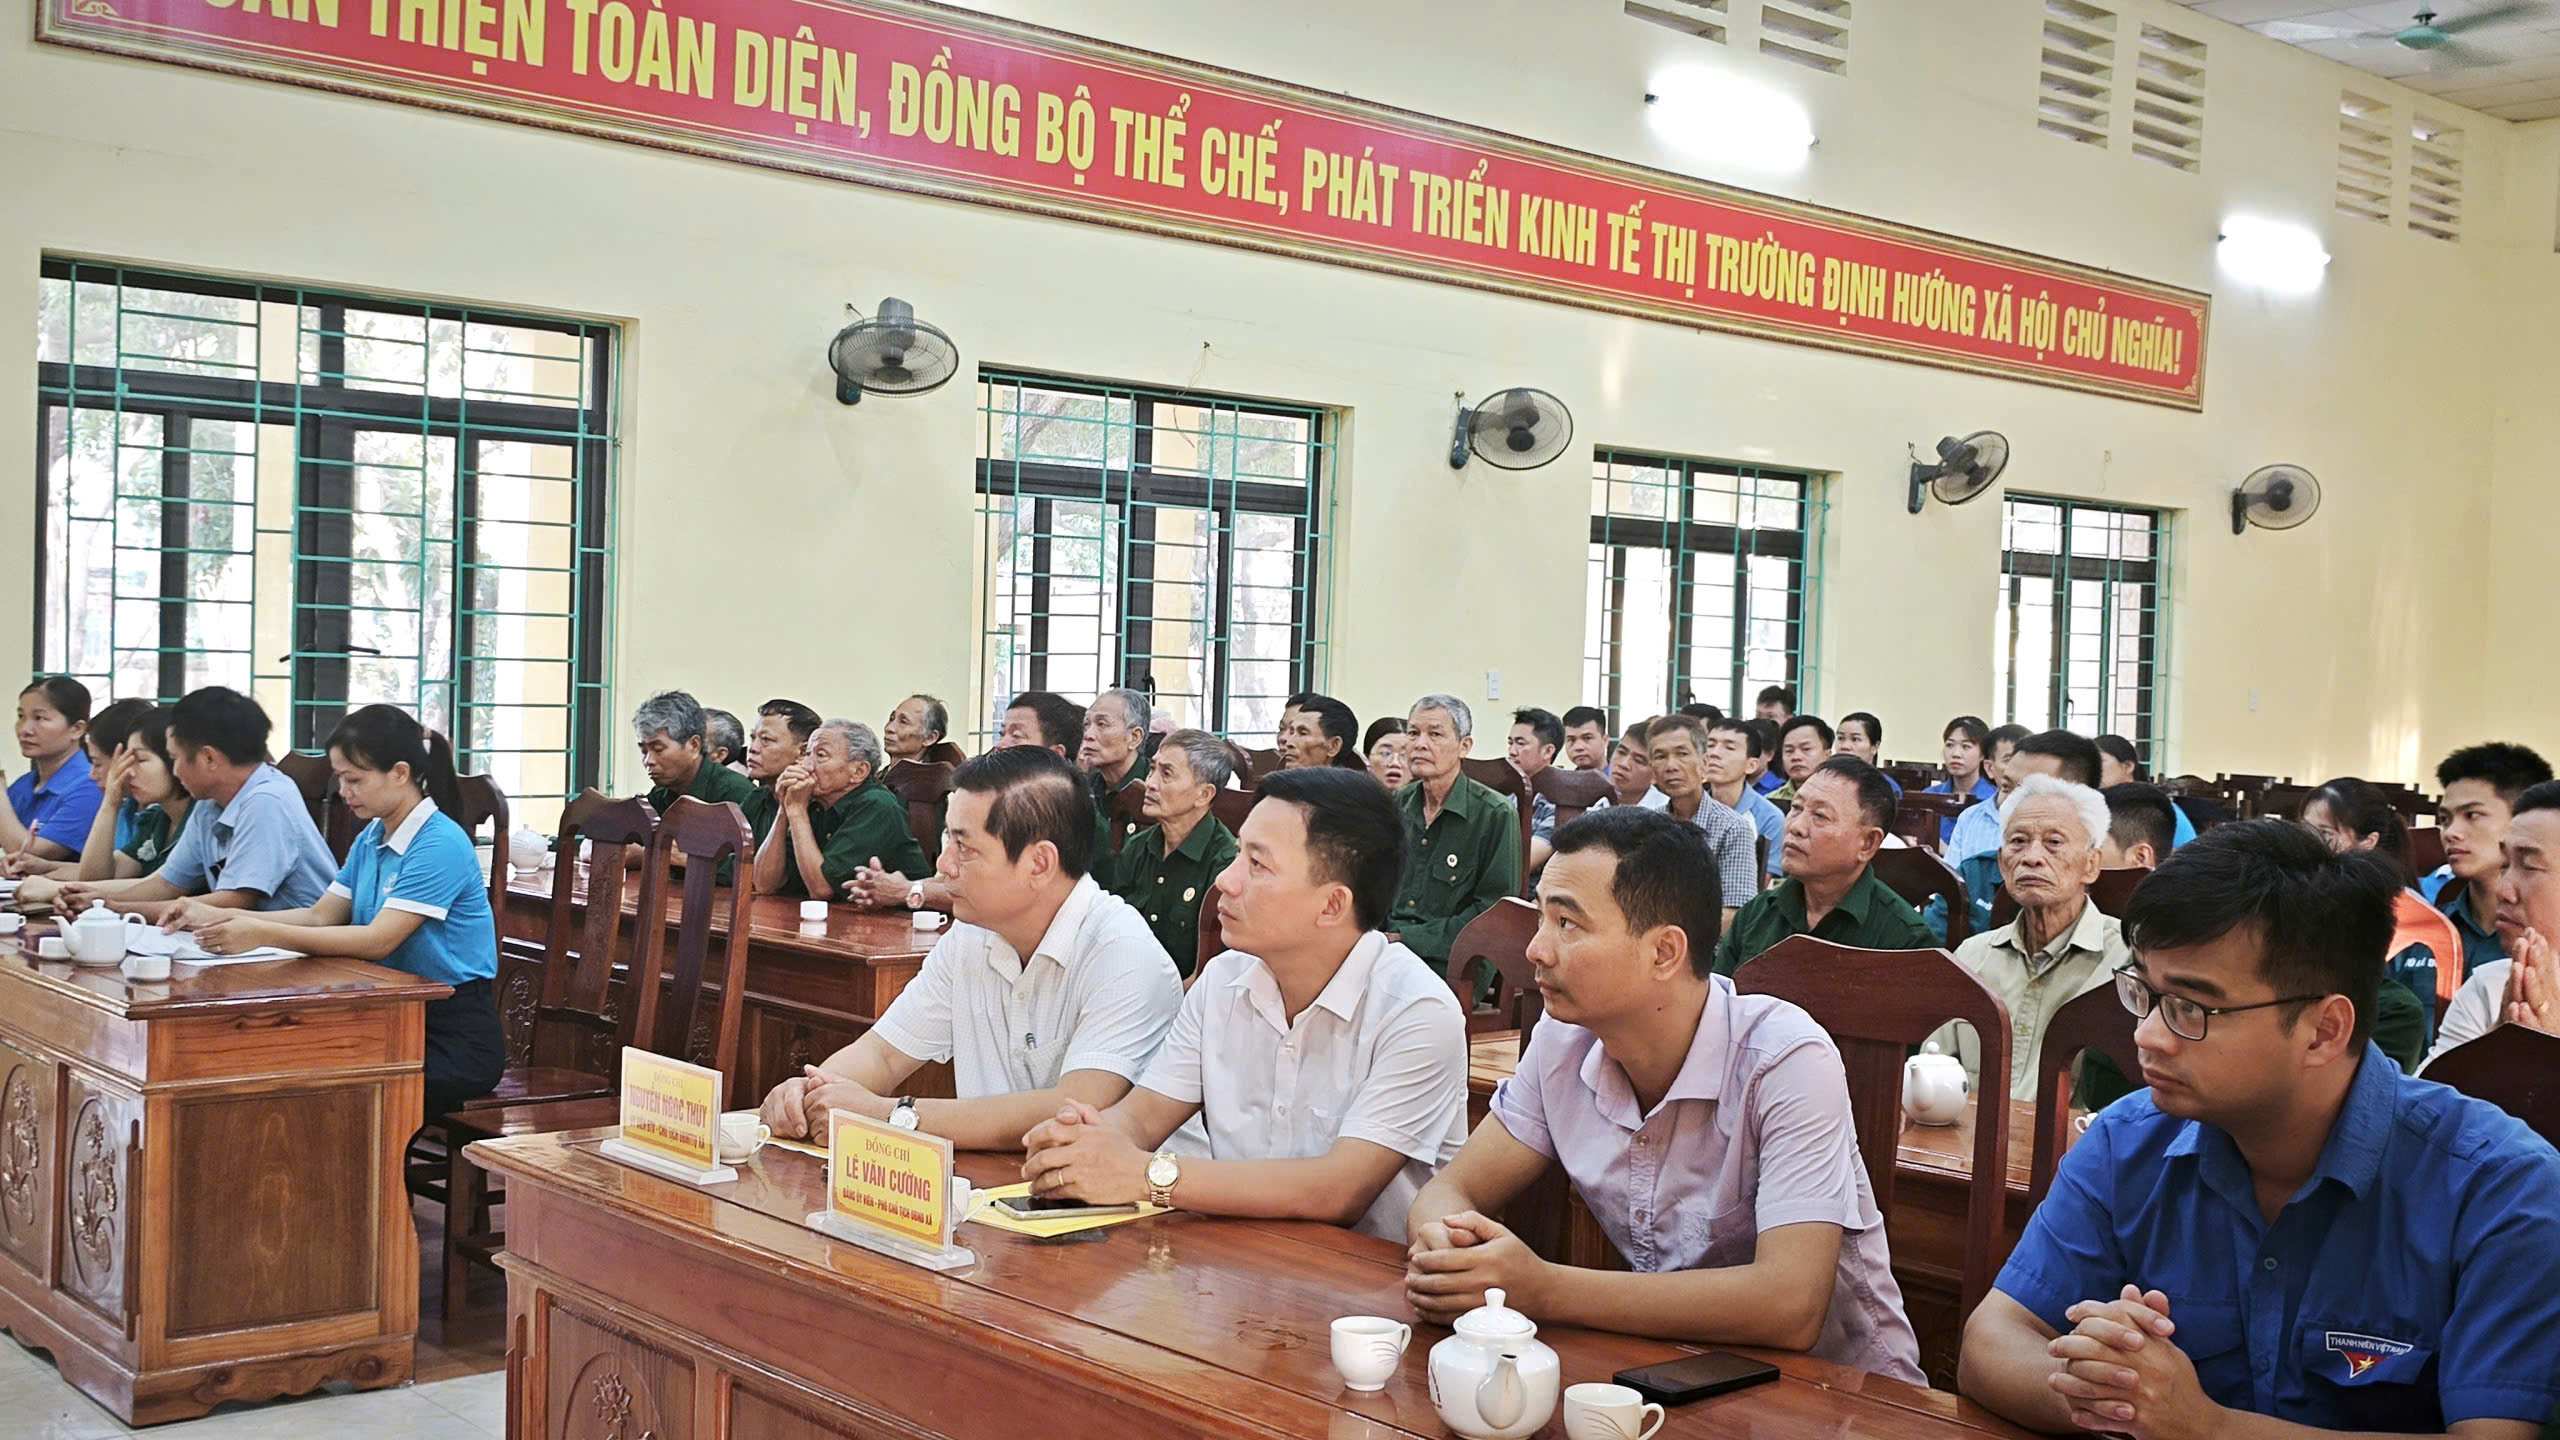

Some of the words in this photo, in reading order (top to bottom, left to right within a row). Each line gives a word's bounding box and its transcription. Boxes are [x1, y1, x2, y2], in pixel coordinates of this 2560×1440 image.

[566, 0, 716, 100] TOÀN
[734, 25, 871, 139] DIỆN,
[888, 46, 1021, 158] ĐỒNG
[1036, 85, 1096, 186] BỘ
[1110, 93, 1191, 189] THỂ
[1200, 119, 1289, 217] CHẾ,
[1302, 146, 1400, 228] PHÁT
[1409, 158, 1510, 250] TRIỂN
[1519, 193, 1598, 266] KINH
[1607, 199, 1647, 276] TẾ
[1651, 221, 1698, 299] THỊ
[1705, 231, 1816, 308] TRƯỜNG
[1822, 256, 1888, 326] ĐỊNH
[1892, 268, 1977, 337] HƯỚNG
[1980, 283, 2014, 344] XÃ
[2019, 290, 2059, 361] HỘI
[2062, 296, 2107, 361] CHỦ
[2110, 315, 2184, 376] NGHĨA!
[846, 1153, 859, 1180] LÊ
[862, 1158, 886, 1188] VĂN
[2330, 1336, 2357, 1348] THANH
